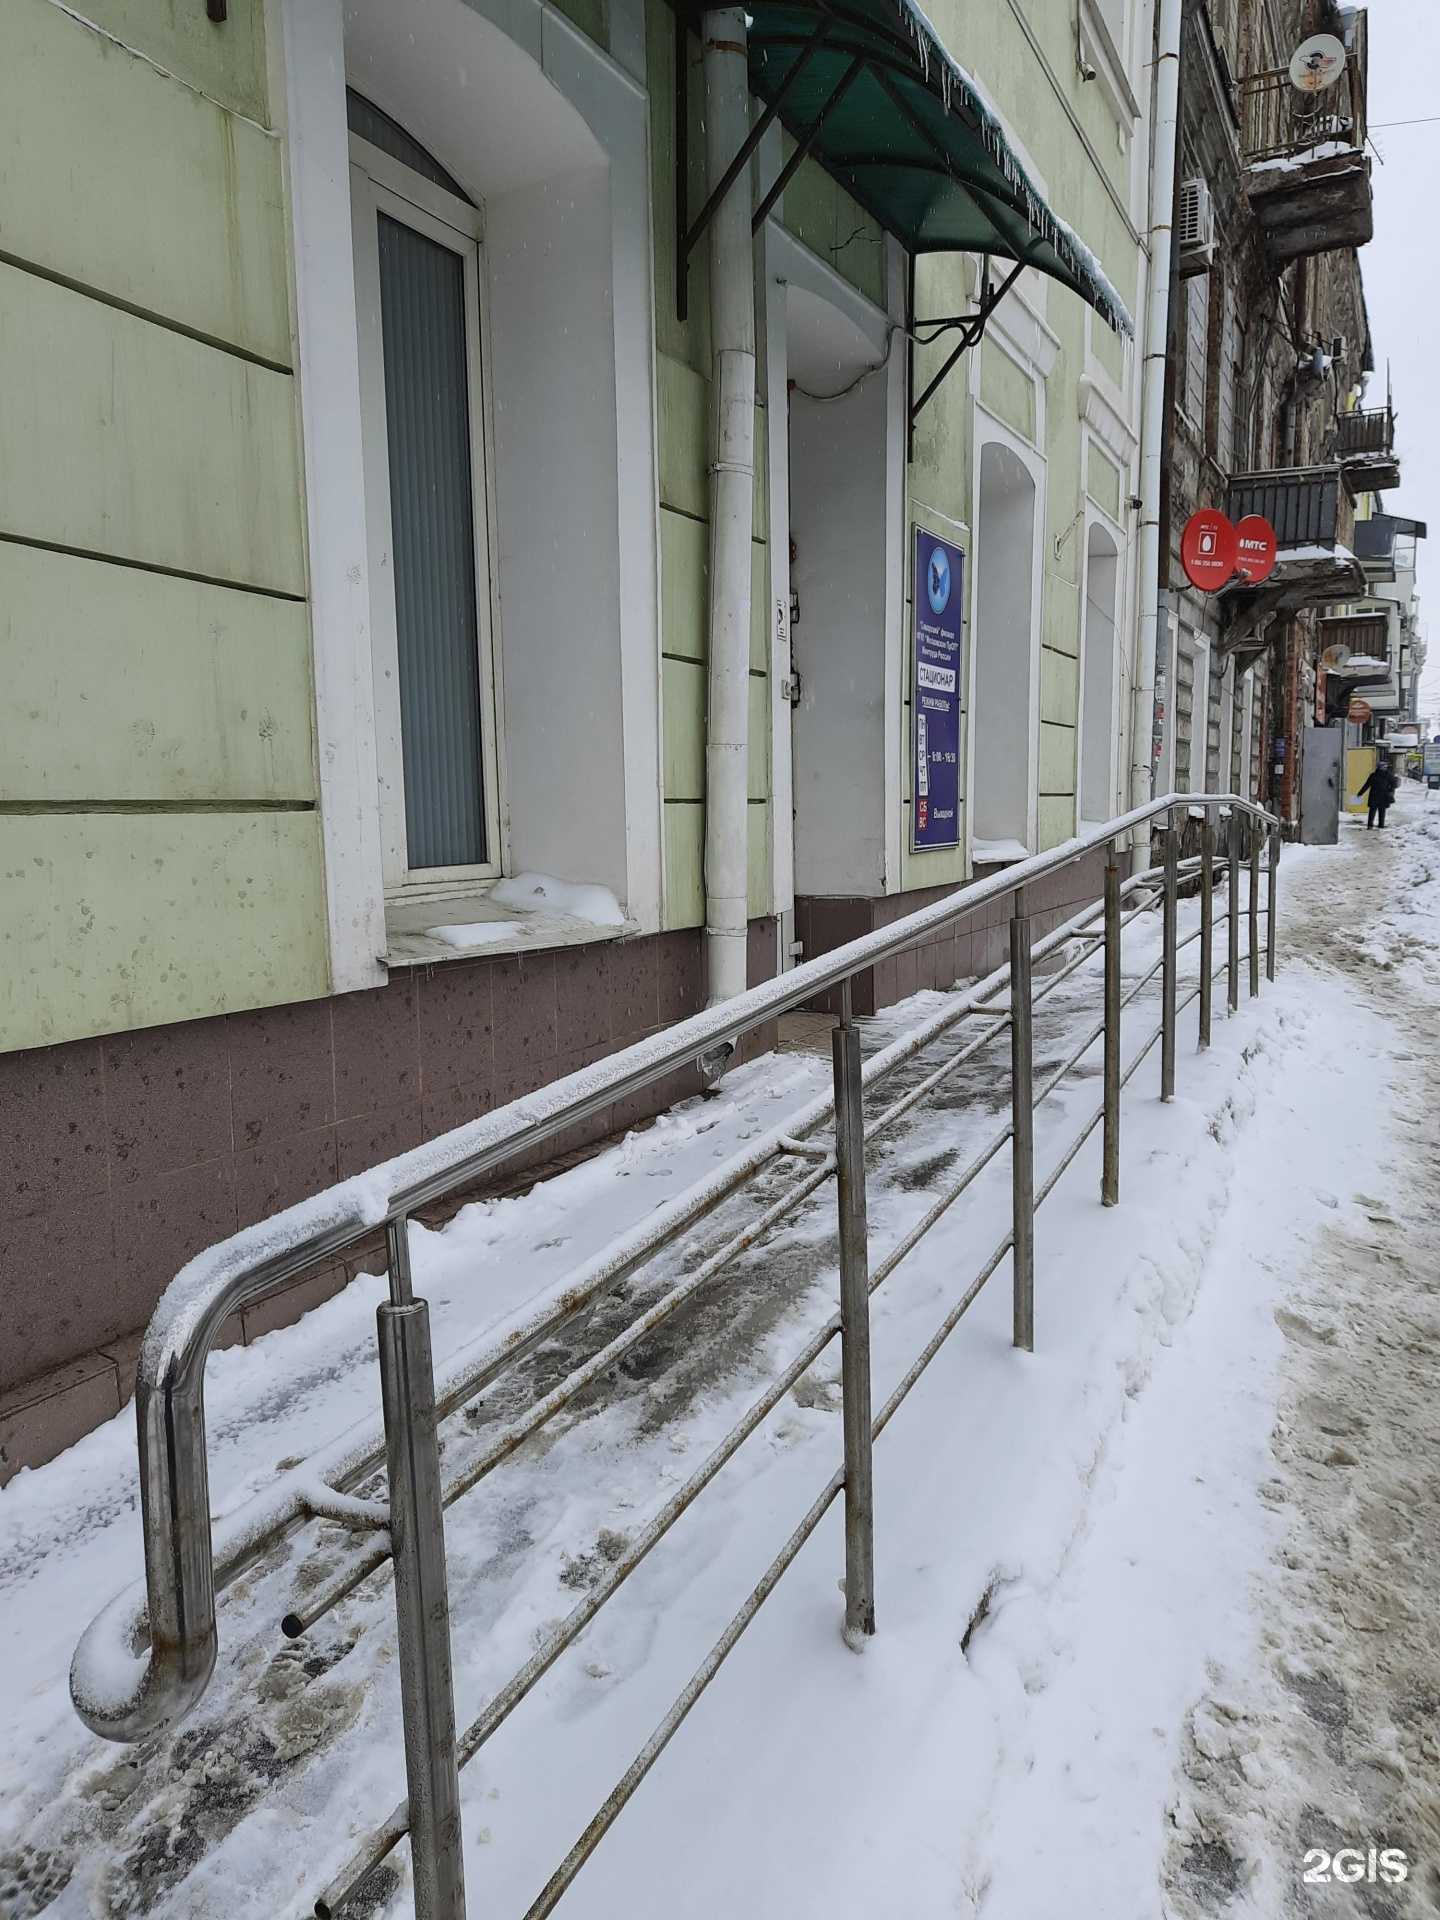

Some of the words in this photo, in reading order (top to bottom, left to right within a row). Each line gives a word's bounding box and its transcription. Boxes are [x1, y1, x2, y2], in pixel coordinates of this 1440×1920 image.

[1244, 539, 1268, 551] МТС
[919, 666, 954, 687] СТАЦИОНАР
[919, 750, 926, 761] СР
[919, 802, 927, 812] СБ
[919, 817, 927, 828] ВС
